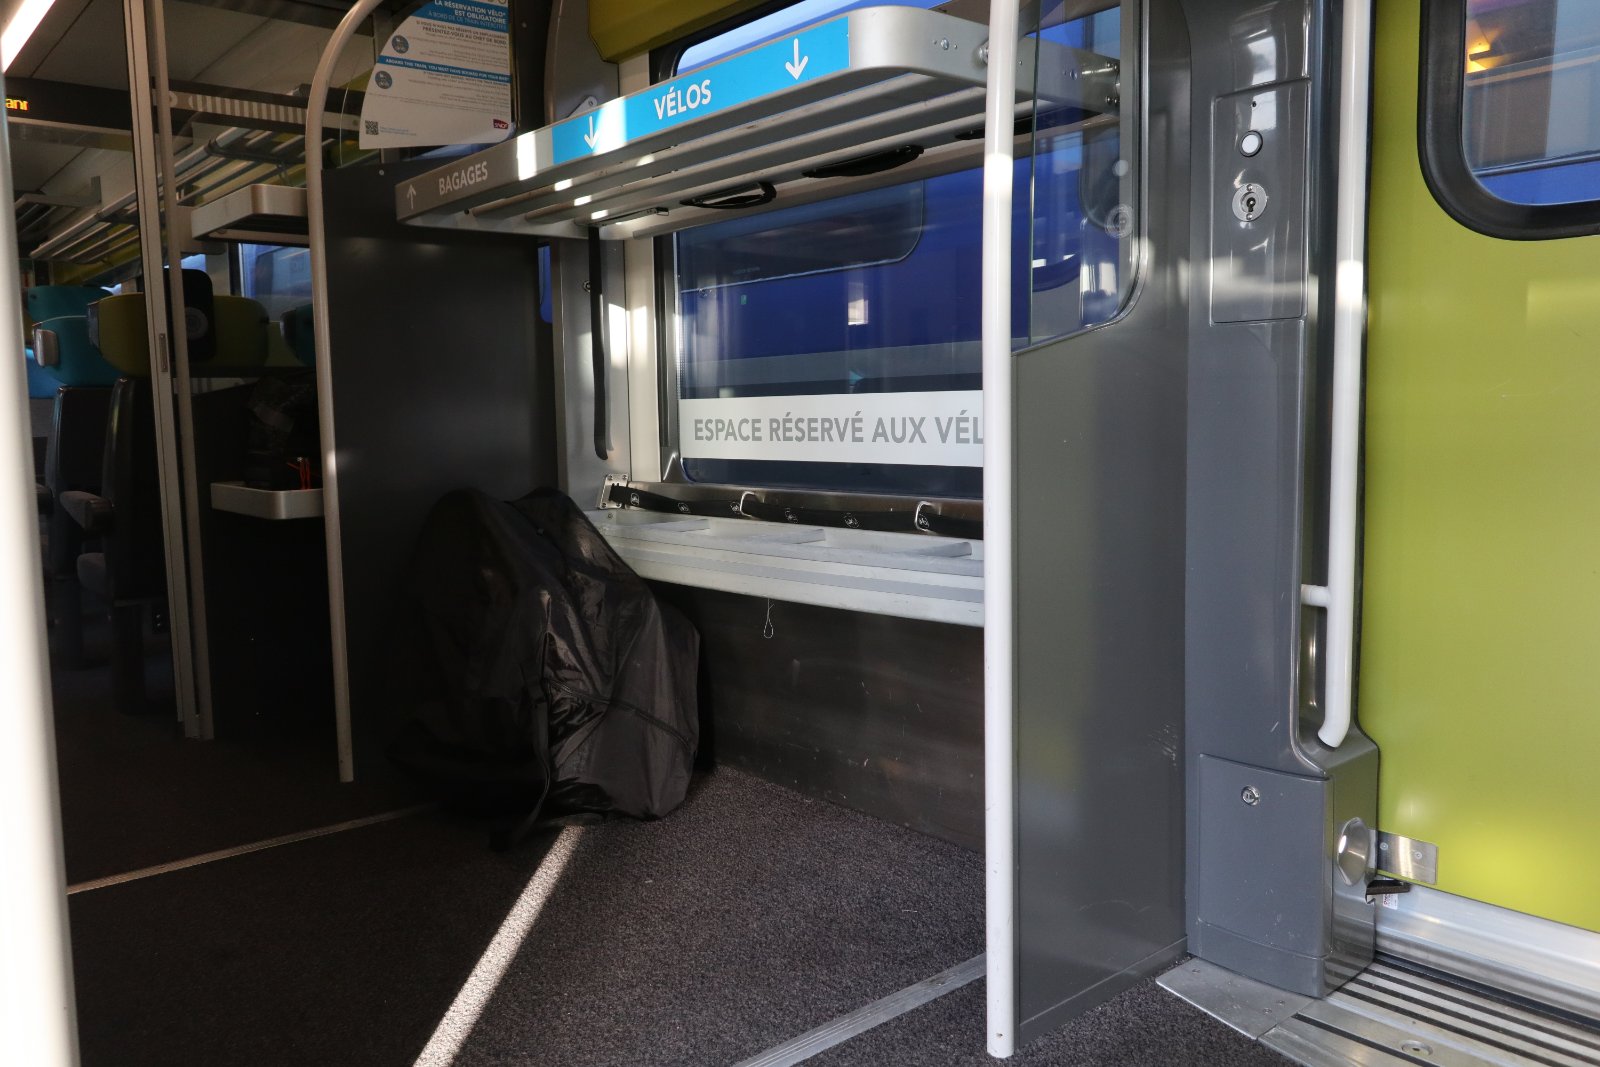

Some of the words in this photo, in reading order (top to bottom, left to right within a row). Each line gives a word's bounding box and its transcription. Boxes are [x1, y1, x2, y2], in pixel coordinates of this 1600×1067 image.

[444, 1, 486, 15] RÉSERVATION
[466, 12, 506, 24] OBLIGATOIRE
[654, 79, 712, 120] VÉLOS
[439, 160, 488, 196] BAGAGES
[694, 418, 763, 442] ESPACE
[769, 411, 864, 443] RÉSERVÉ
[872, 417, 928, 444] AUX
[935, 410, 984, 445] VÉL
